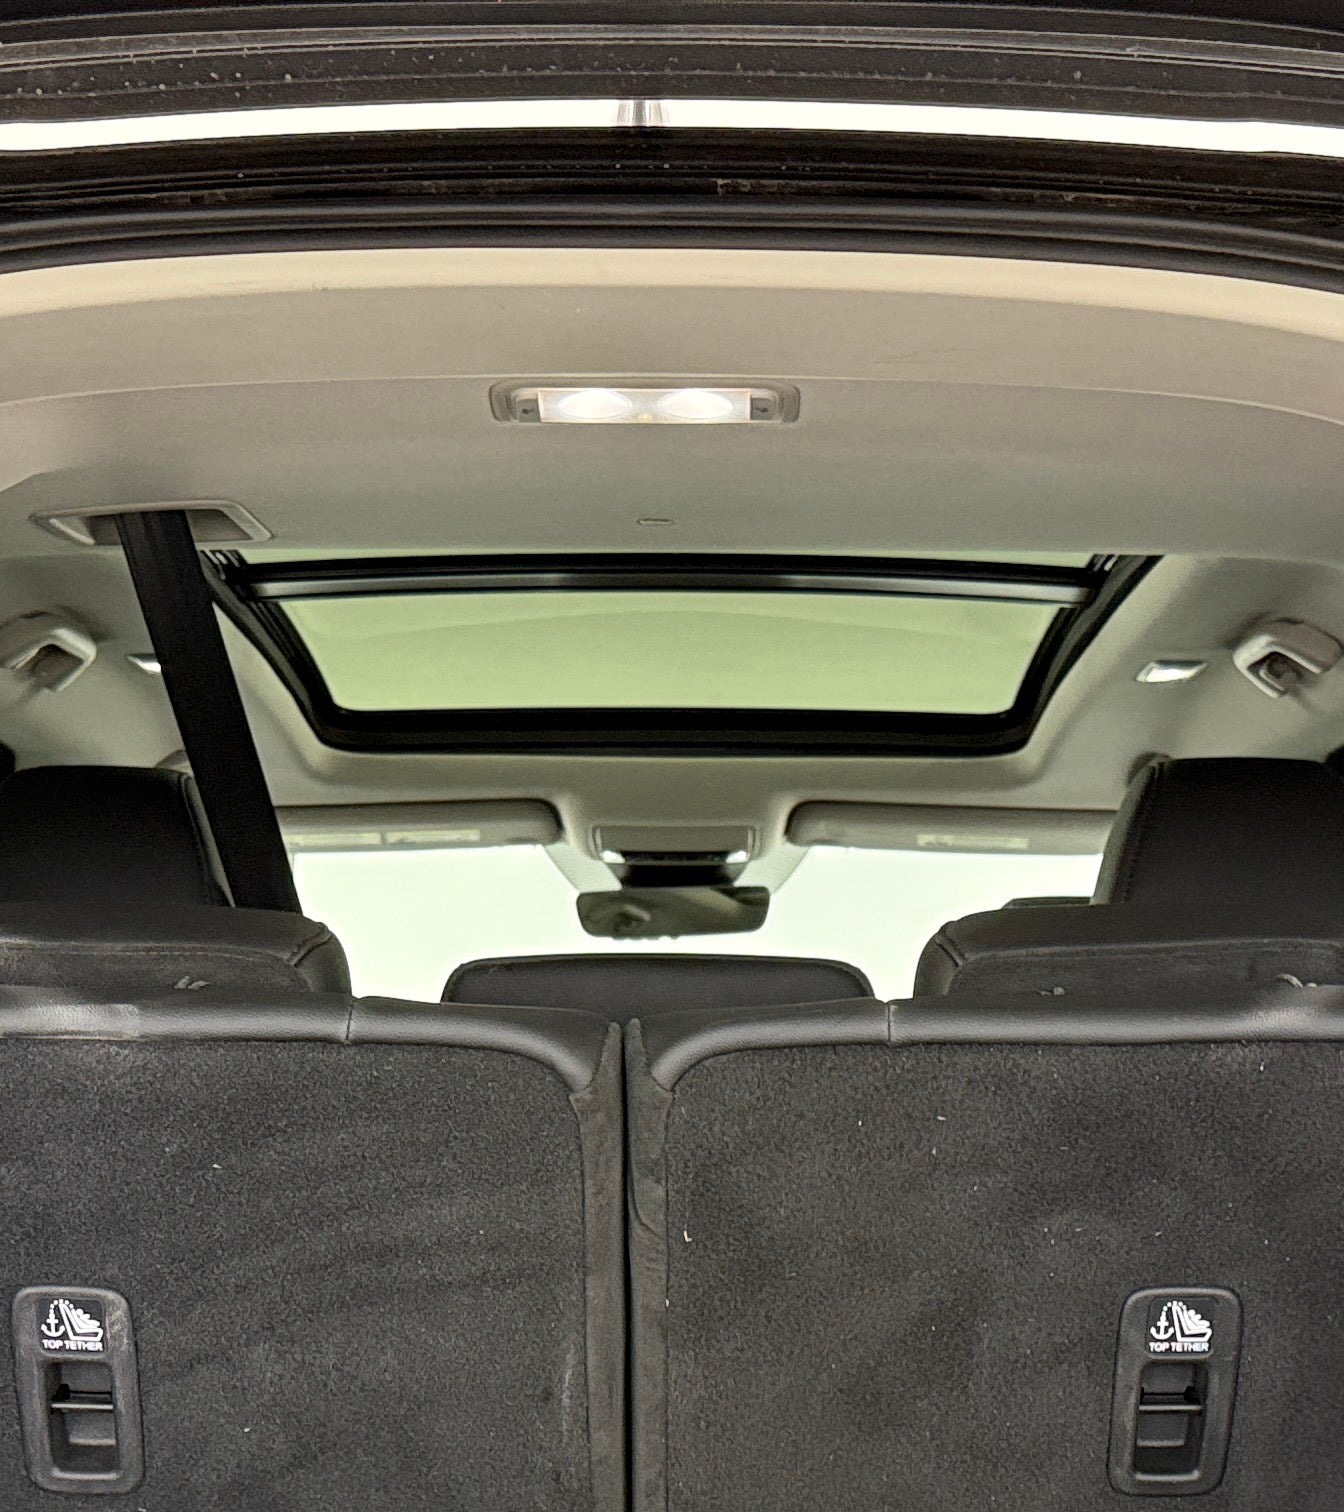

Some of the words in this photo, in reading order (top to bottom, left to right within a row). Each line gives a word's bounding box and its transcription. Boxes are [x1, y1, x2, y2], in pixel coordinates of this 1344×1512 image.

[42, 1339, 64, 1350] TOP
[64, 1339, 104, 1351] TETHER
[1149, 1341, 1169, 1352] TOP
[1171, 1341, 1210, 1352] TETHER
